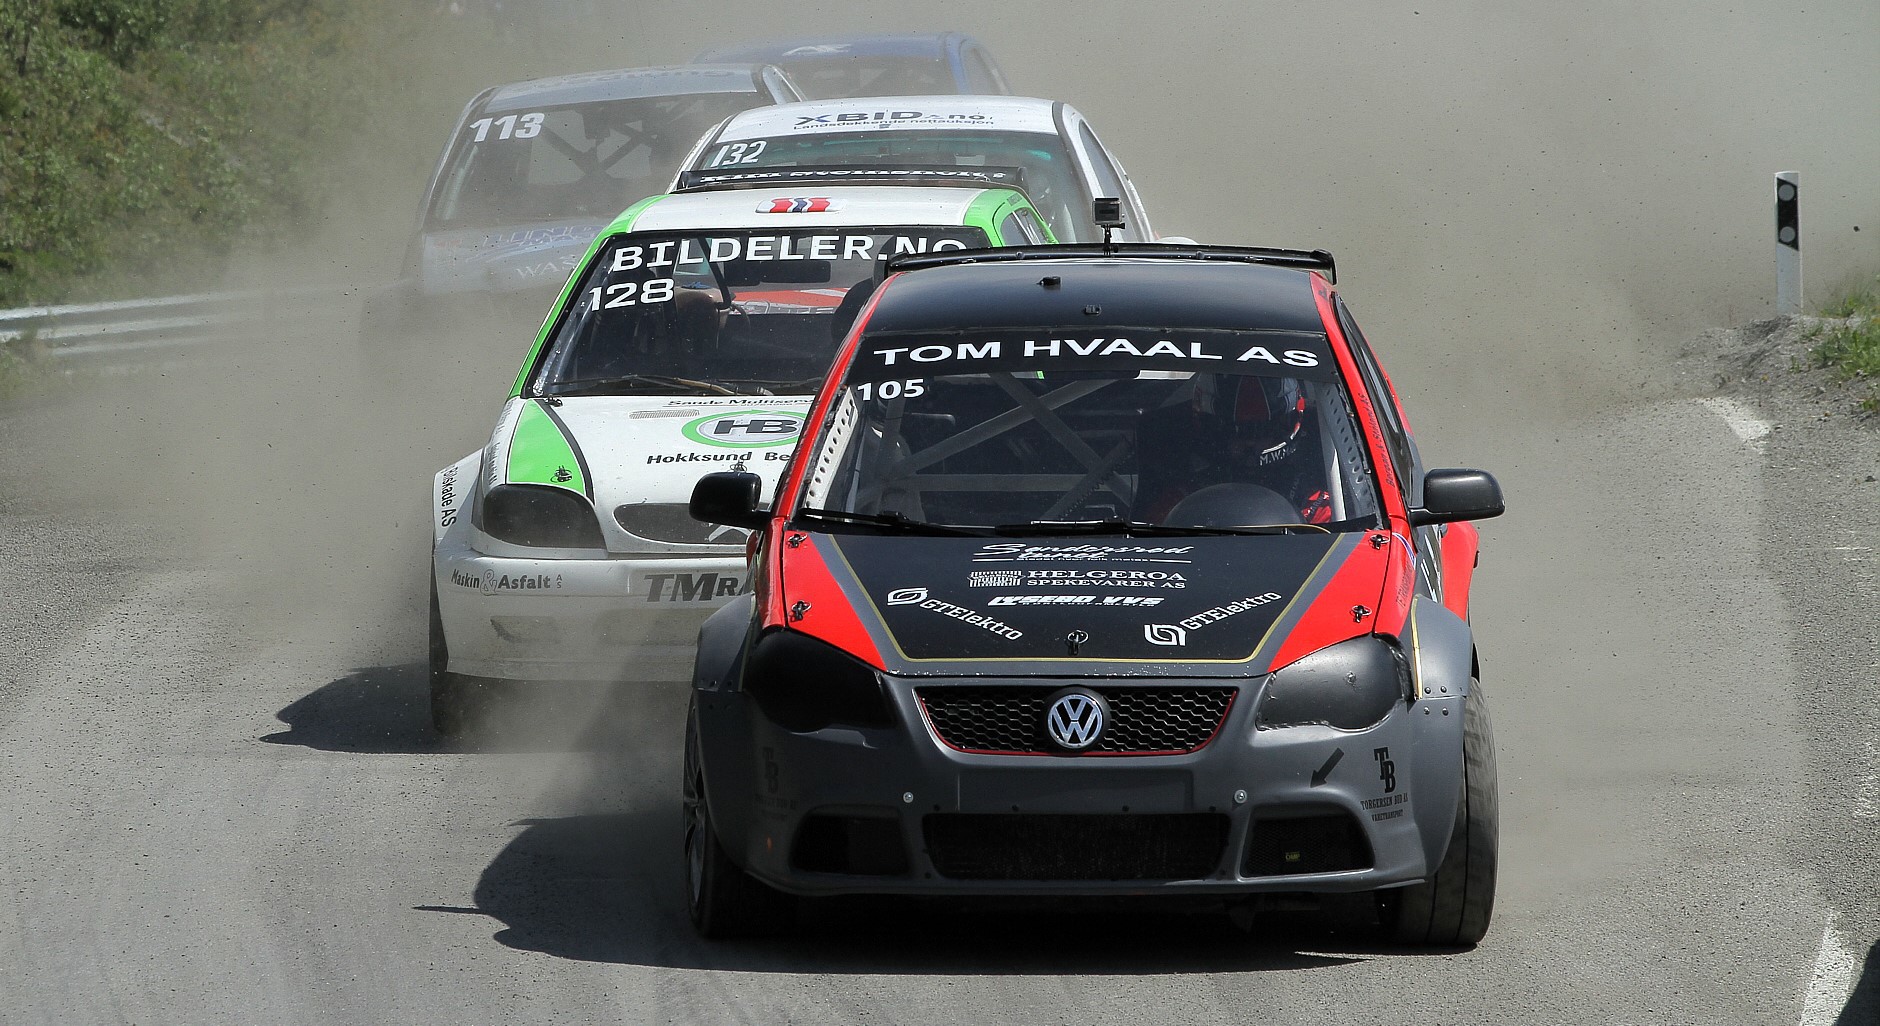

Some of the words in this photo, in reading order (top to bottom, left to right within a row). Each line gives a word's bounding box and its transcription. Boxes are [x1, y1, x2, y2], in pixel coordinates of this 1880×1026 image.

[469, 112, 545, 142] 113
[710, 139, 767, 168] 132
[588, 277, 675, 312] 128
[873, 341, 1002, 366] TOM
[1023, 338, 1223, 360] HVAAL
[1236, 345, 1320, 367] AS
[857, 378, 925, 401] 105
[713, 419, 799, 434] HB
[646, 452, 752, 465] Hokksund
[765, 452, 790, 463] Be
[441, 508, 457, 528] AS
[451, 568, 479, 588] Maskin
[480, 568, 497, 596] &
[497, 574, 550, 589] Asfalt
[644, 572, 745, 602] TMR
[1026, 579, 1156, 588] SPEKEVARER
[1161, 581, 1187, 589] AS
[1027, 570, 1187, 582] HELGEROA
[1102, 596, 1165, 607] VVS
[1179, 591, 1282, 632] GTElektro
[919, 598, 1024, 641] GTElektro
[1360, 796, 1393, 811] TORGERSEN
